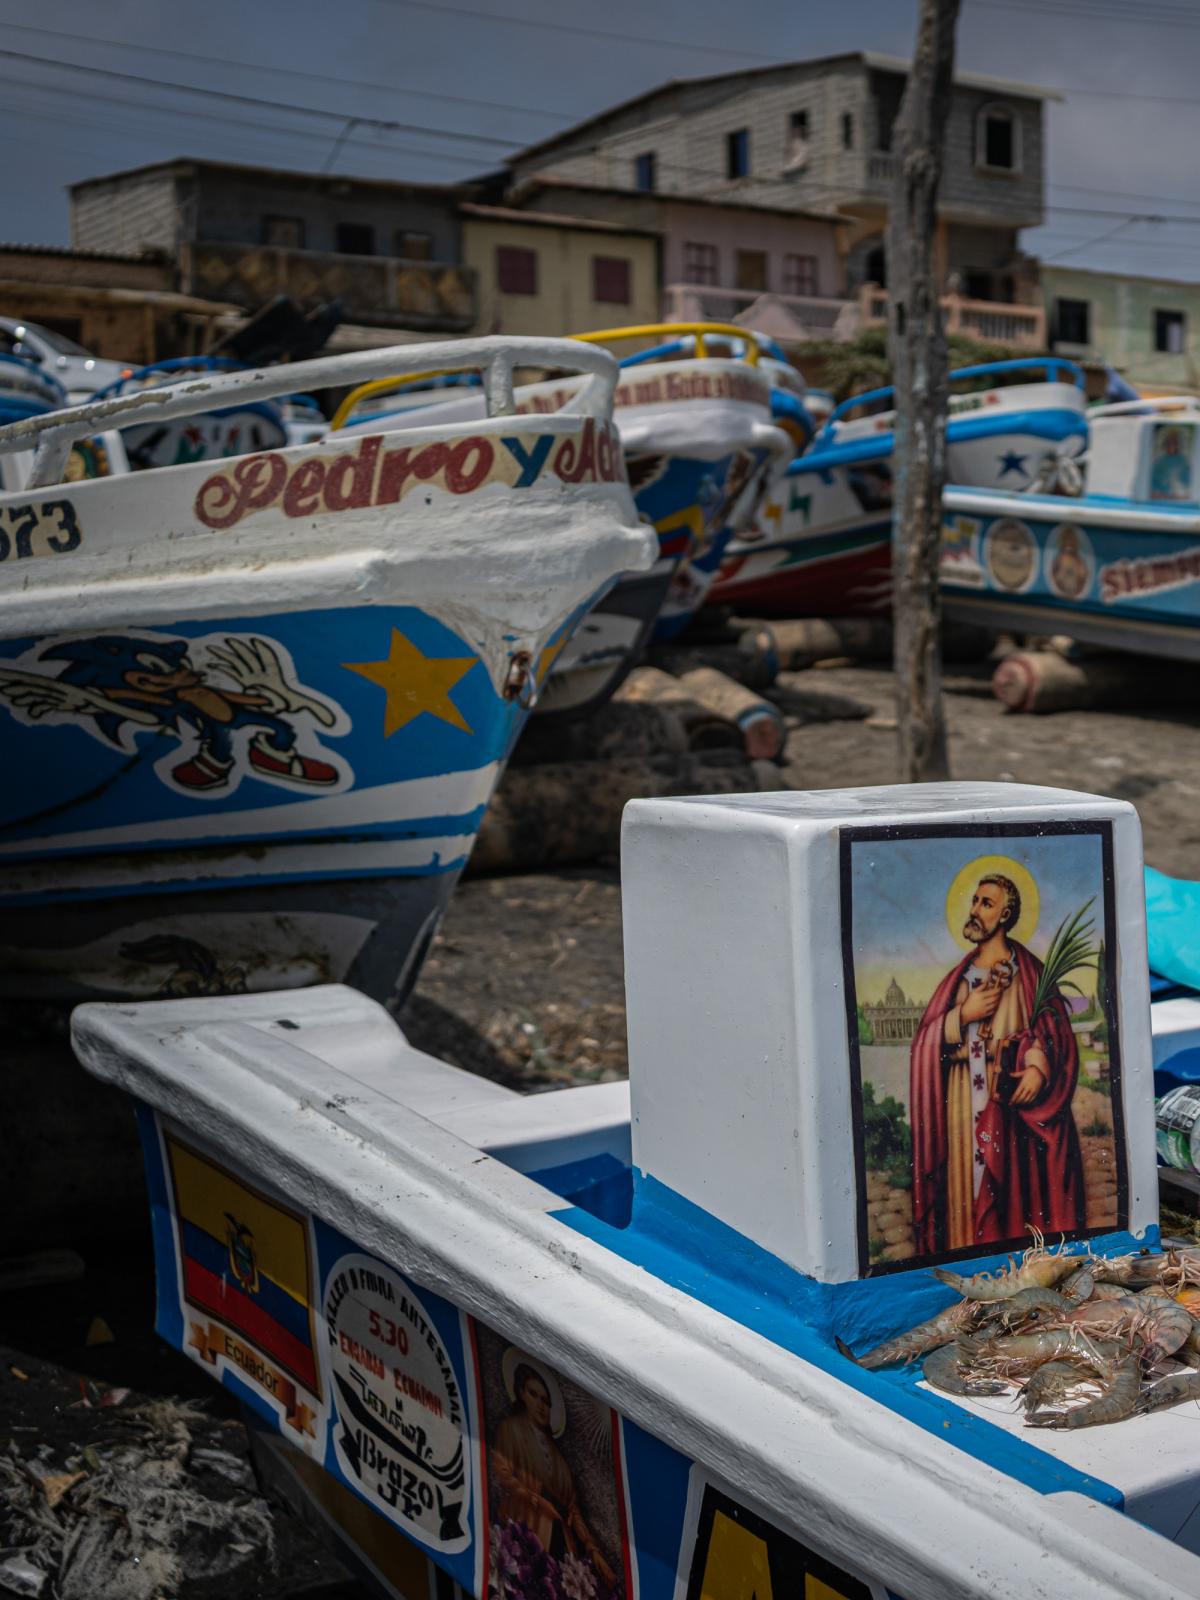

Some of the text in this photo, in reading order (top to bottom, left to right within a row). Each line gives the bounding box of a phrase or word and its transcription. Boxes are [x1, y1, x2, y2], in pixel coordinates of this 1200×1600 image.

[195, 435, 494, 529] Pedro
[368, 1310, 409, 1356] 5.30
[224, 1335, 278, 1393] Ecuador
